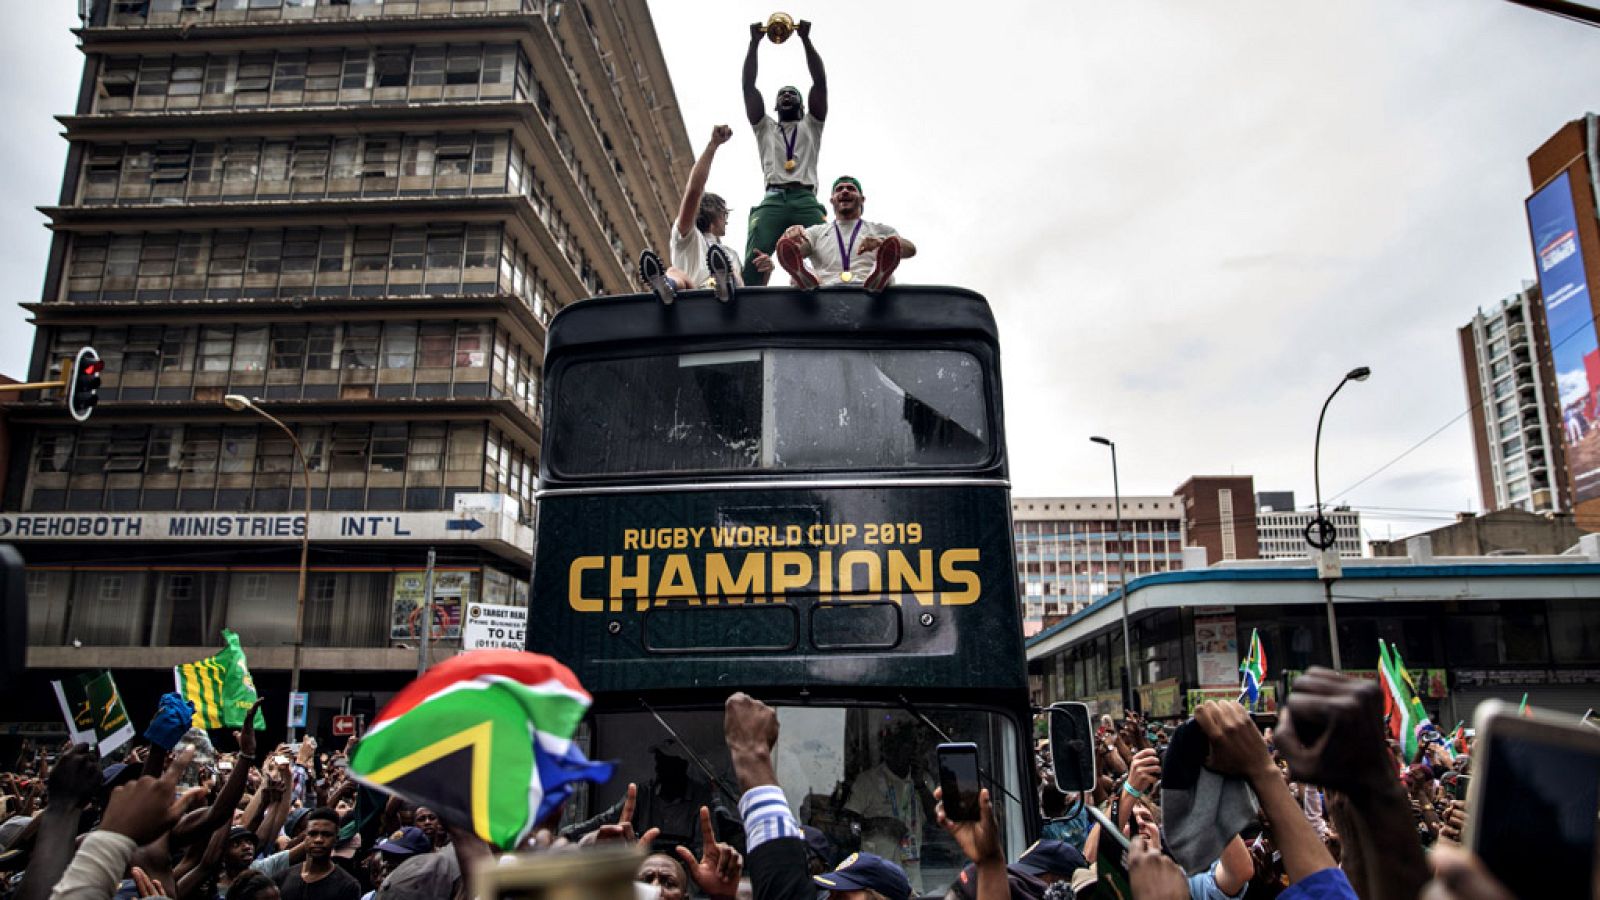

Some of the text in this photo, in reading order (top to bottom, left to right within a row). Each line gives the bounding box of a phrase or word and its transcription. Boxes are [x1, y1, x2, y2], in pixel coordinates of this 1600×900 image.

[15, 517, 142, 536] REHOBOTH
[168, 516, 306, 536] MINISTRIES
[624, 522, 923, 550] RUGBY WORLD CUP 2019
[568, 548, 981, 612] CHAMPIONS
[483, 608, 508, 617] TARGET
[488, 628, 526, 640] TO LE
